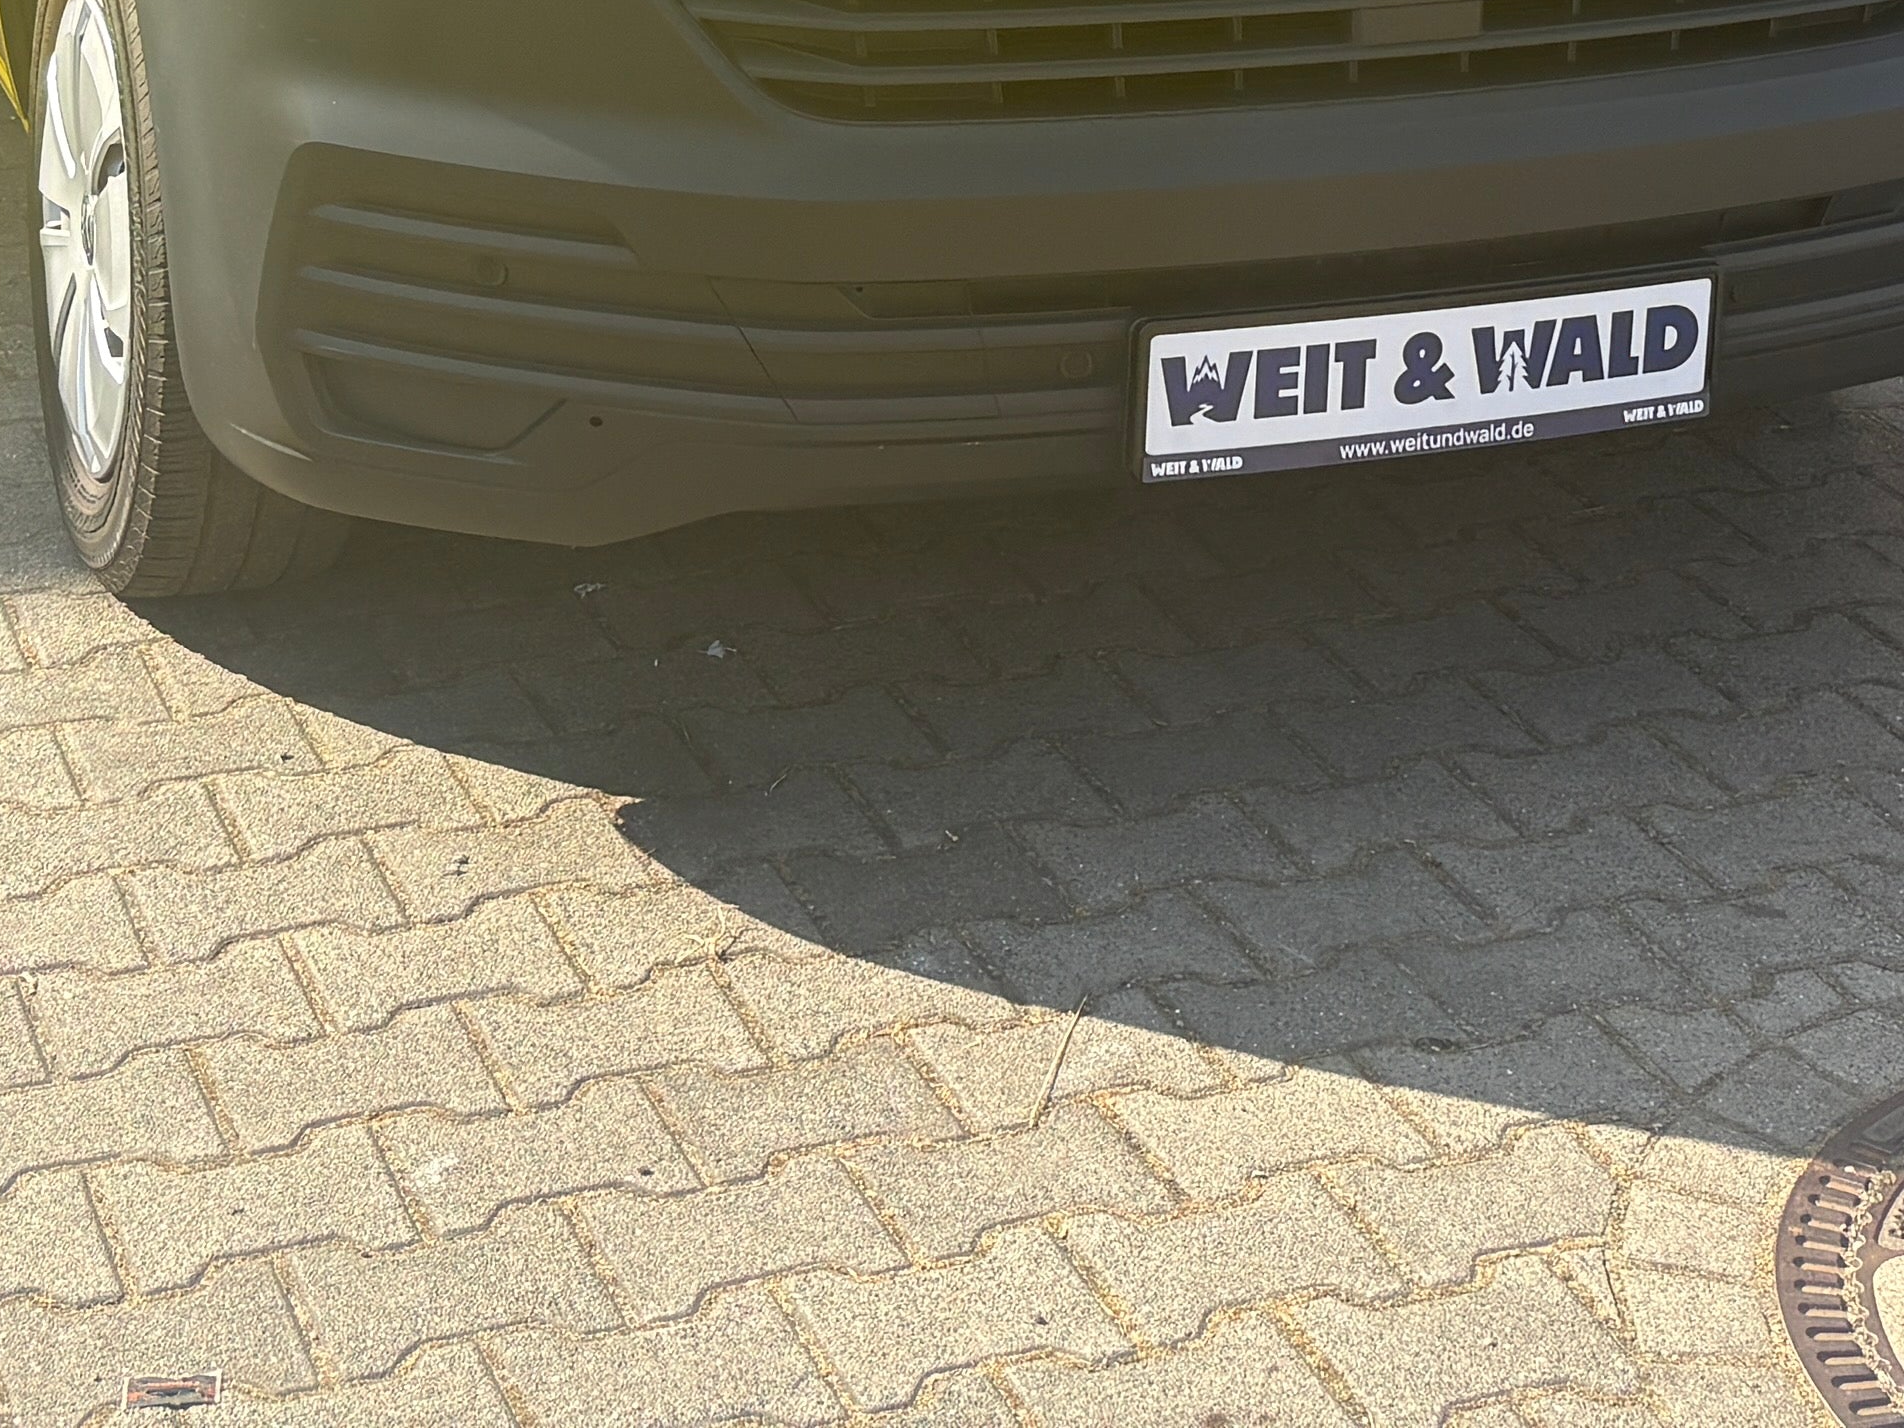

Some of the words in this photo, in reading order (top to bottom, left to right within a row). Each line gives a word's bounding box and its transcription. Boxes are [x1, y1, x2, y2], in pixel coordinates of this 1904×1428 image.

[1161, 339, 1377, 427] WEIT
[1394, 331, 1455, 405] &
[1472, 304, 1698, 395] WALD
[1622, 406, 1655, 423] WEIT
[1656, 405, 1666, 419] &
[1667, 400, 1704, 417] WALD
[1339, 421, 1534, 459] www.weitundwald.de
[1151, 460, 1188, 477] WEIT
[1189, 460, 1200, 474] &
[1201, 456, 1243, 473] WALD
